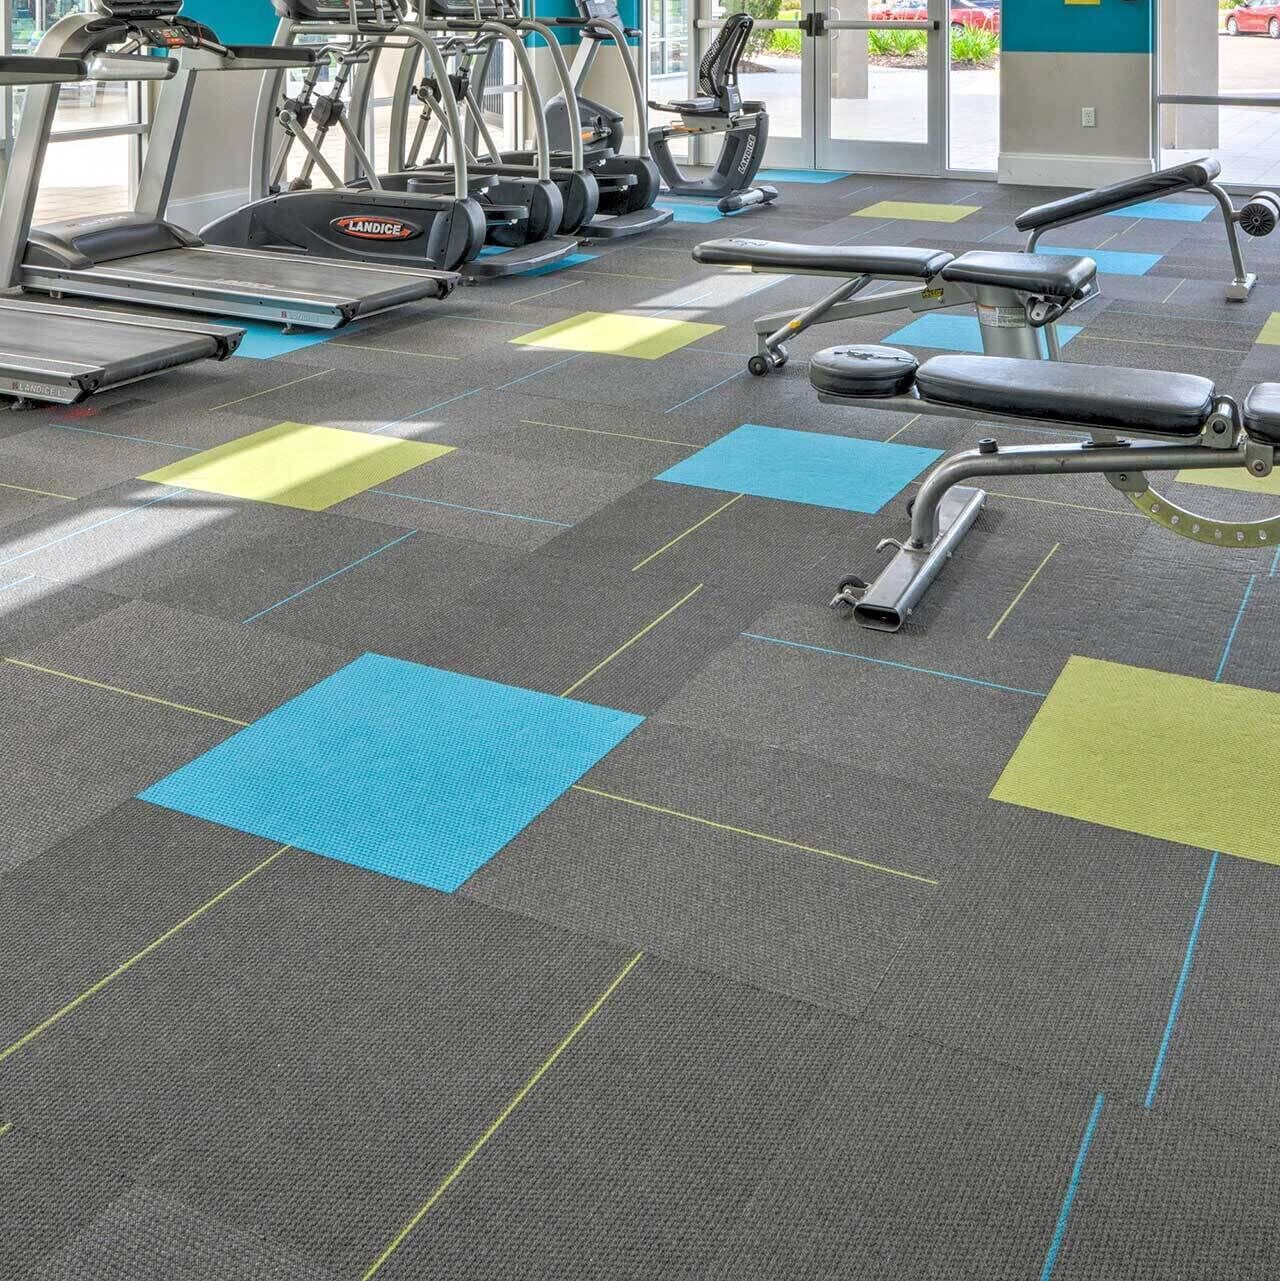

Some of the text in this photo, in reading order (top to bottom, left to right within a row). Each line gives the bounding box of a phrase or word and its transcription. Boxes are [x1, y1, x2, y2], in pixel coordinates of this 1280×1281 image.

[738, 134, 756, 174] LANDICE
[348, 220, 402, 235] LANDICE
[19, 382, 57, 396] LANDICE
